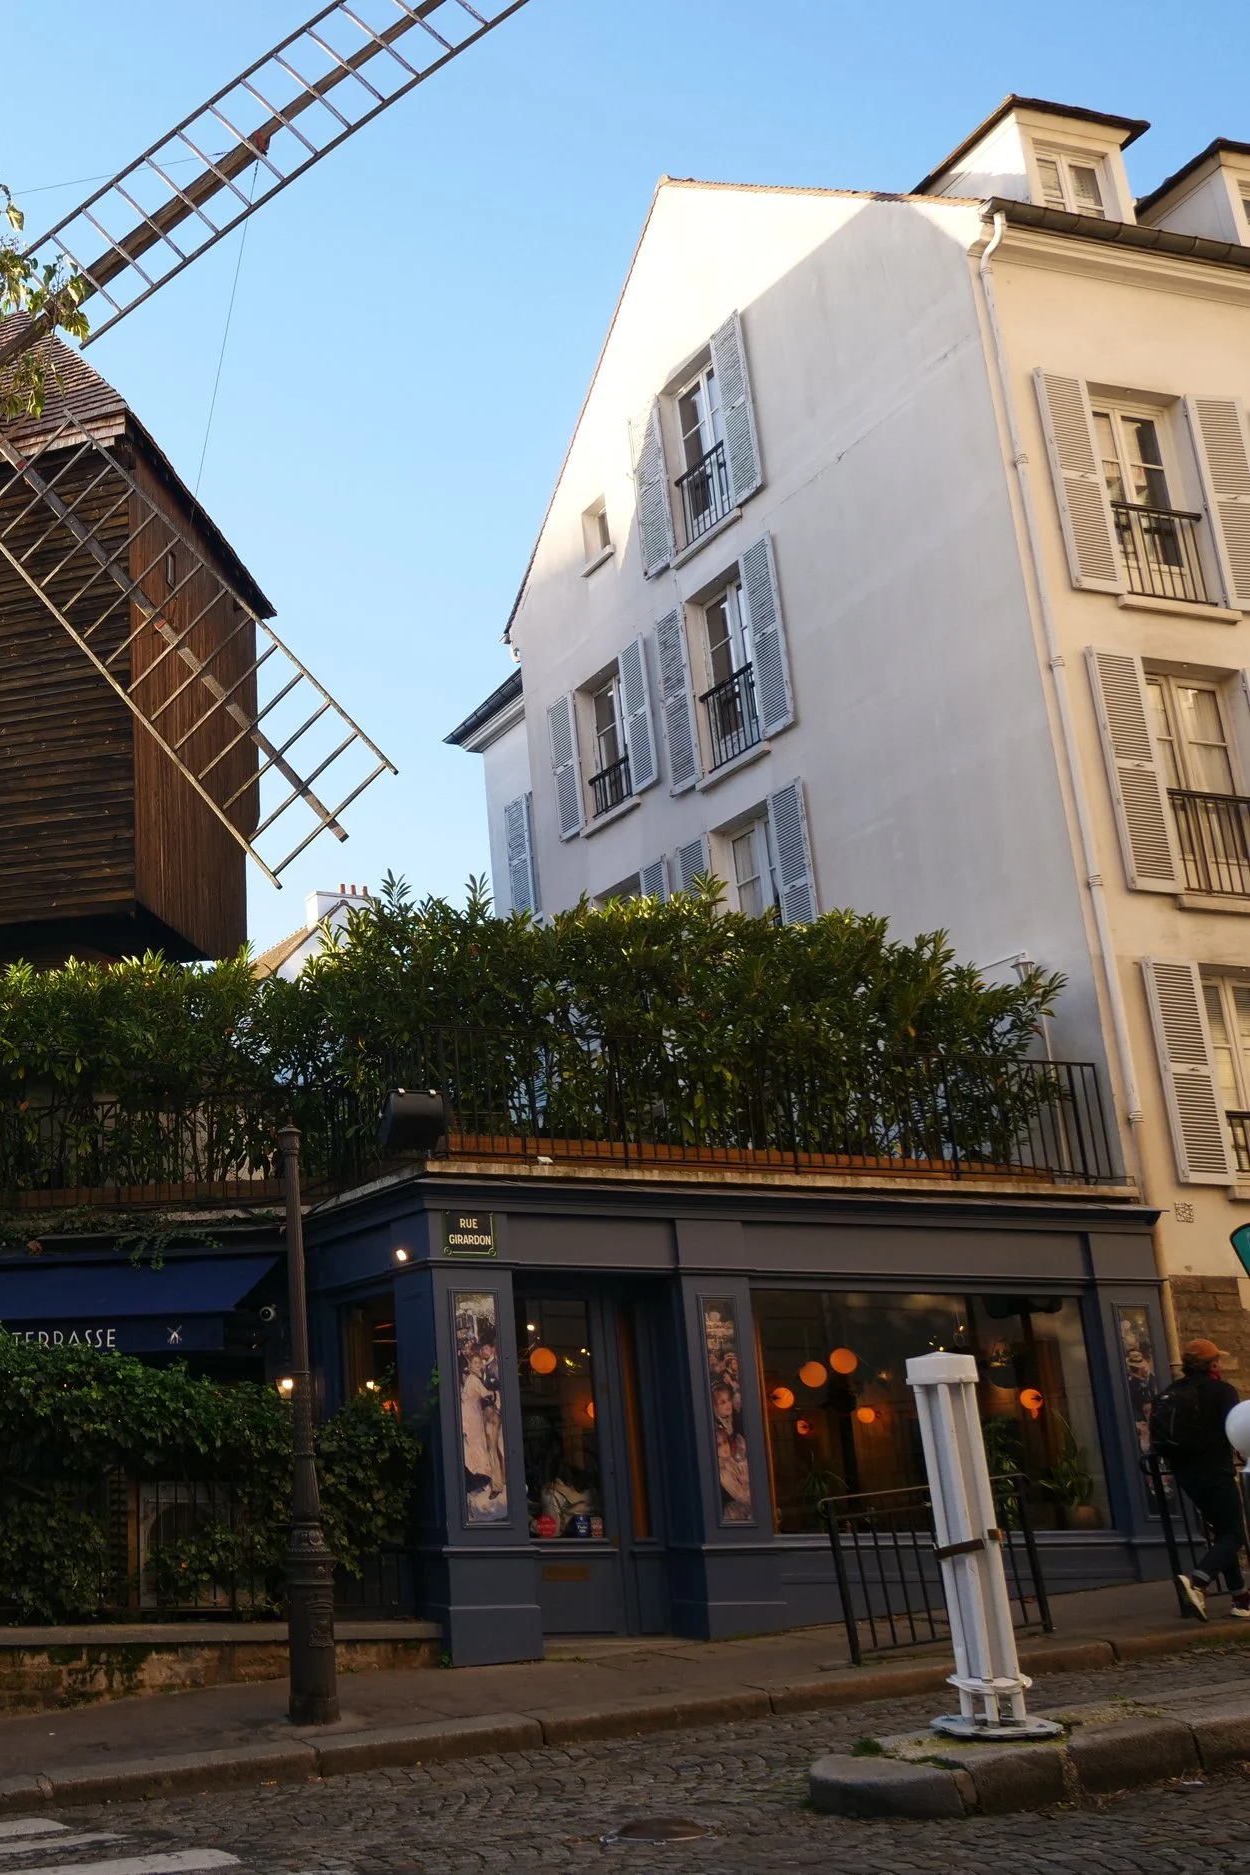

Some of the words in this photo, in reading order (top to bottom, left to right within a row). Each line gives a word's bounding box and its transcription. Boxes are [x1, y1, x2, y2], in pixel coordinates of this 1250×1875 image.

[459, 1218, 479, 1229] RUE
[448, 1234, 492, 1246] GIRARDON
[12, 1329, 116, 1349] TERRASSE
